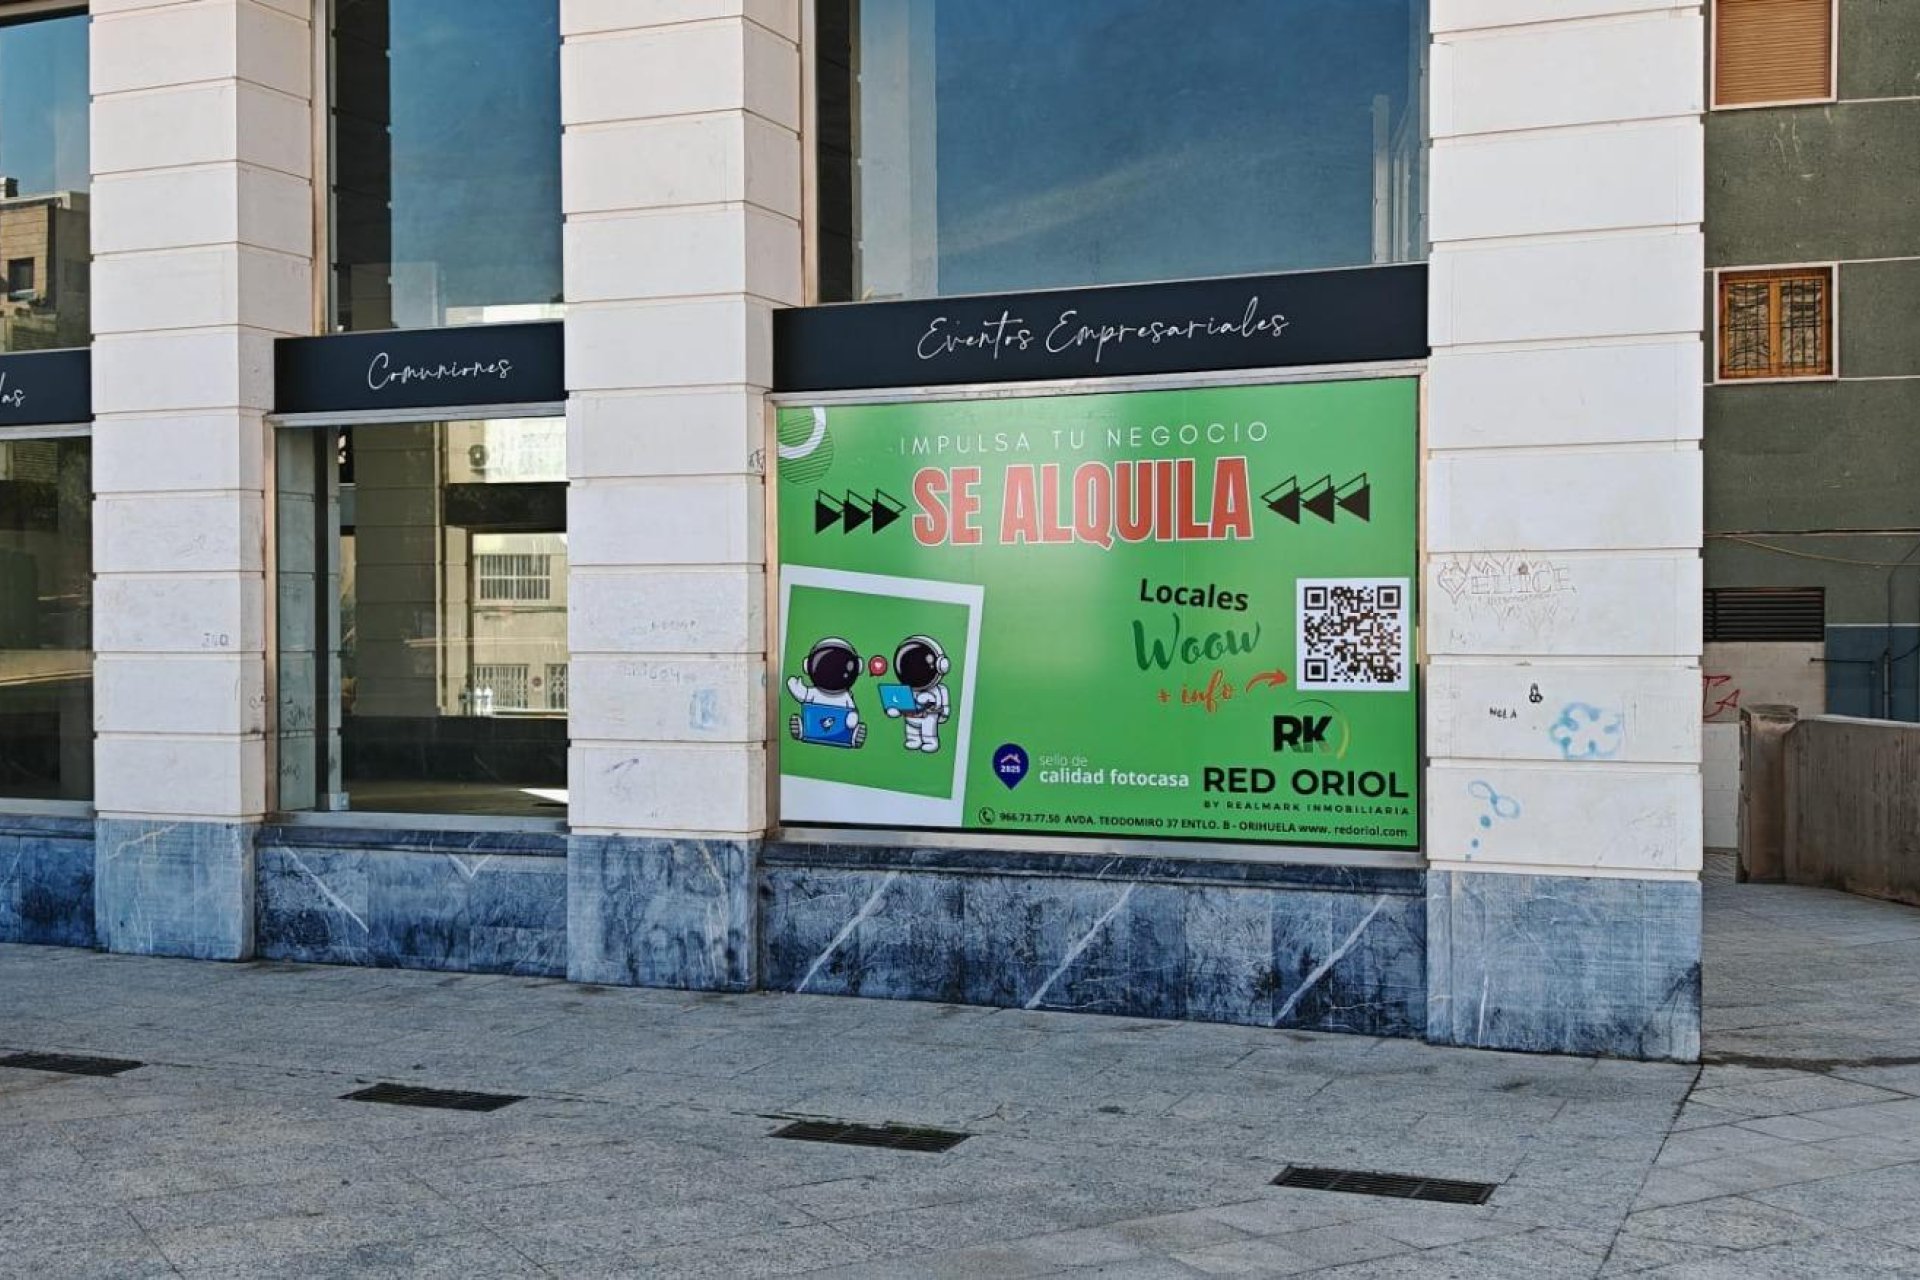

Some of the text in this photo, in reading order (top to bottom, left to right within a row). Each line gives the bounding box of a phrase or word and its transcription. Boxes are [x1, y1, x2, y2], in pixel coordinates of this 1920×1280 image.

[917, 295, 1291, 363] Eventos Empresariales
[367, 352, 513, 391] Comuniones
[900, 421, 1270, 456] IMPULSA TU NEGOCIO
[911, 456, 1254, 550] SE ALQUILA
[1140, 578, 1249, 612] Locales
[1131, 612, 1261, 671] Woow
[1181, 669, 1235, 713] info
[1273, 714, 1334, 754] RK
[1039, 754, 1088, 767] sello de
[1039, 768, 1190, 788] calidad fotocasa
[1203, 767, 1409, 799] RED ORIOL
[1099, 815, 1164, 829] TEODOMIRO
[1166, 819, 1178, 828] 37
[1239, 820, 1297, 833] ORIHUELA
[1227, 801, 1300, 812] REALMARK
[1307, 804, 1410, 816] INMOBILIARIA
